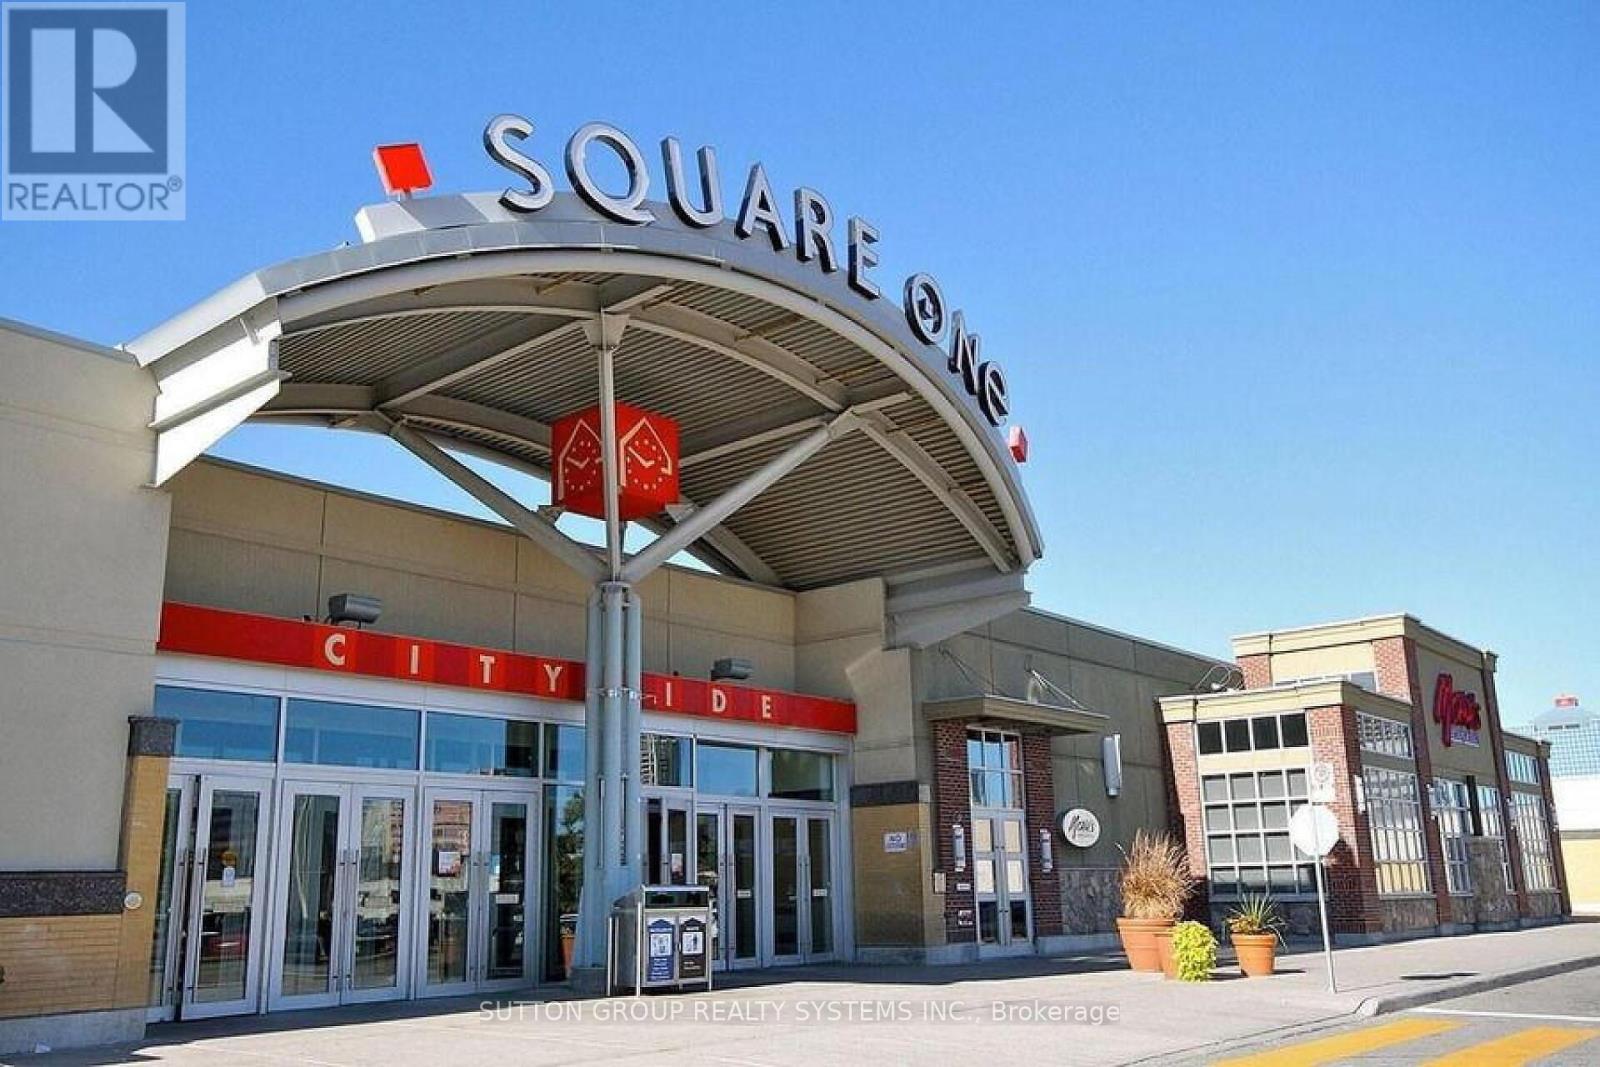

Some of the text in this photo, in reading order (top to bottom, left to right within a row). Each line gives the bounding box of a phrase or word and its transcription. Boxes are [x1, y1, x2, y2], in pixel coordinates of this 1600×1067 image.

[483, 113, 881, 299] SQUARE
[324, 632, 773, 719] CITY IDE
